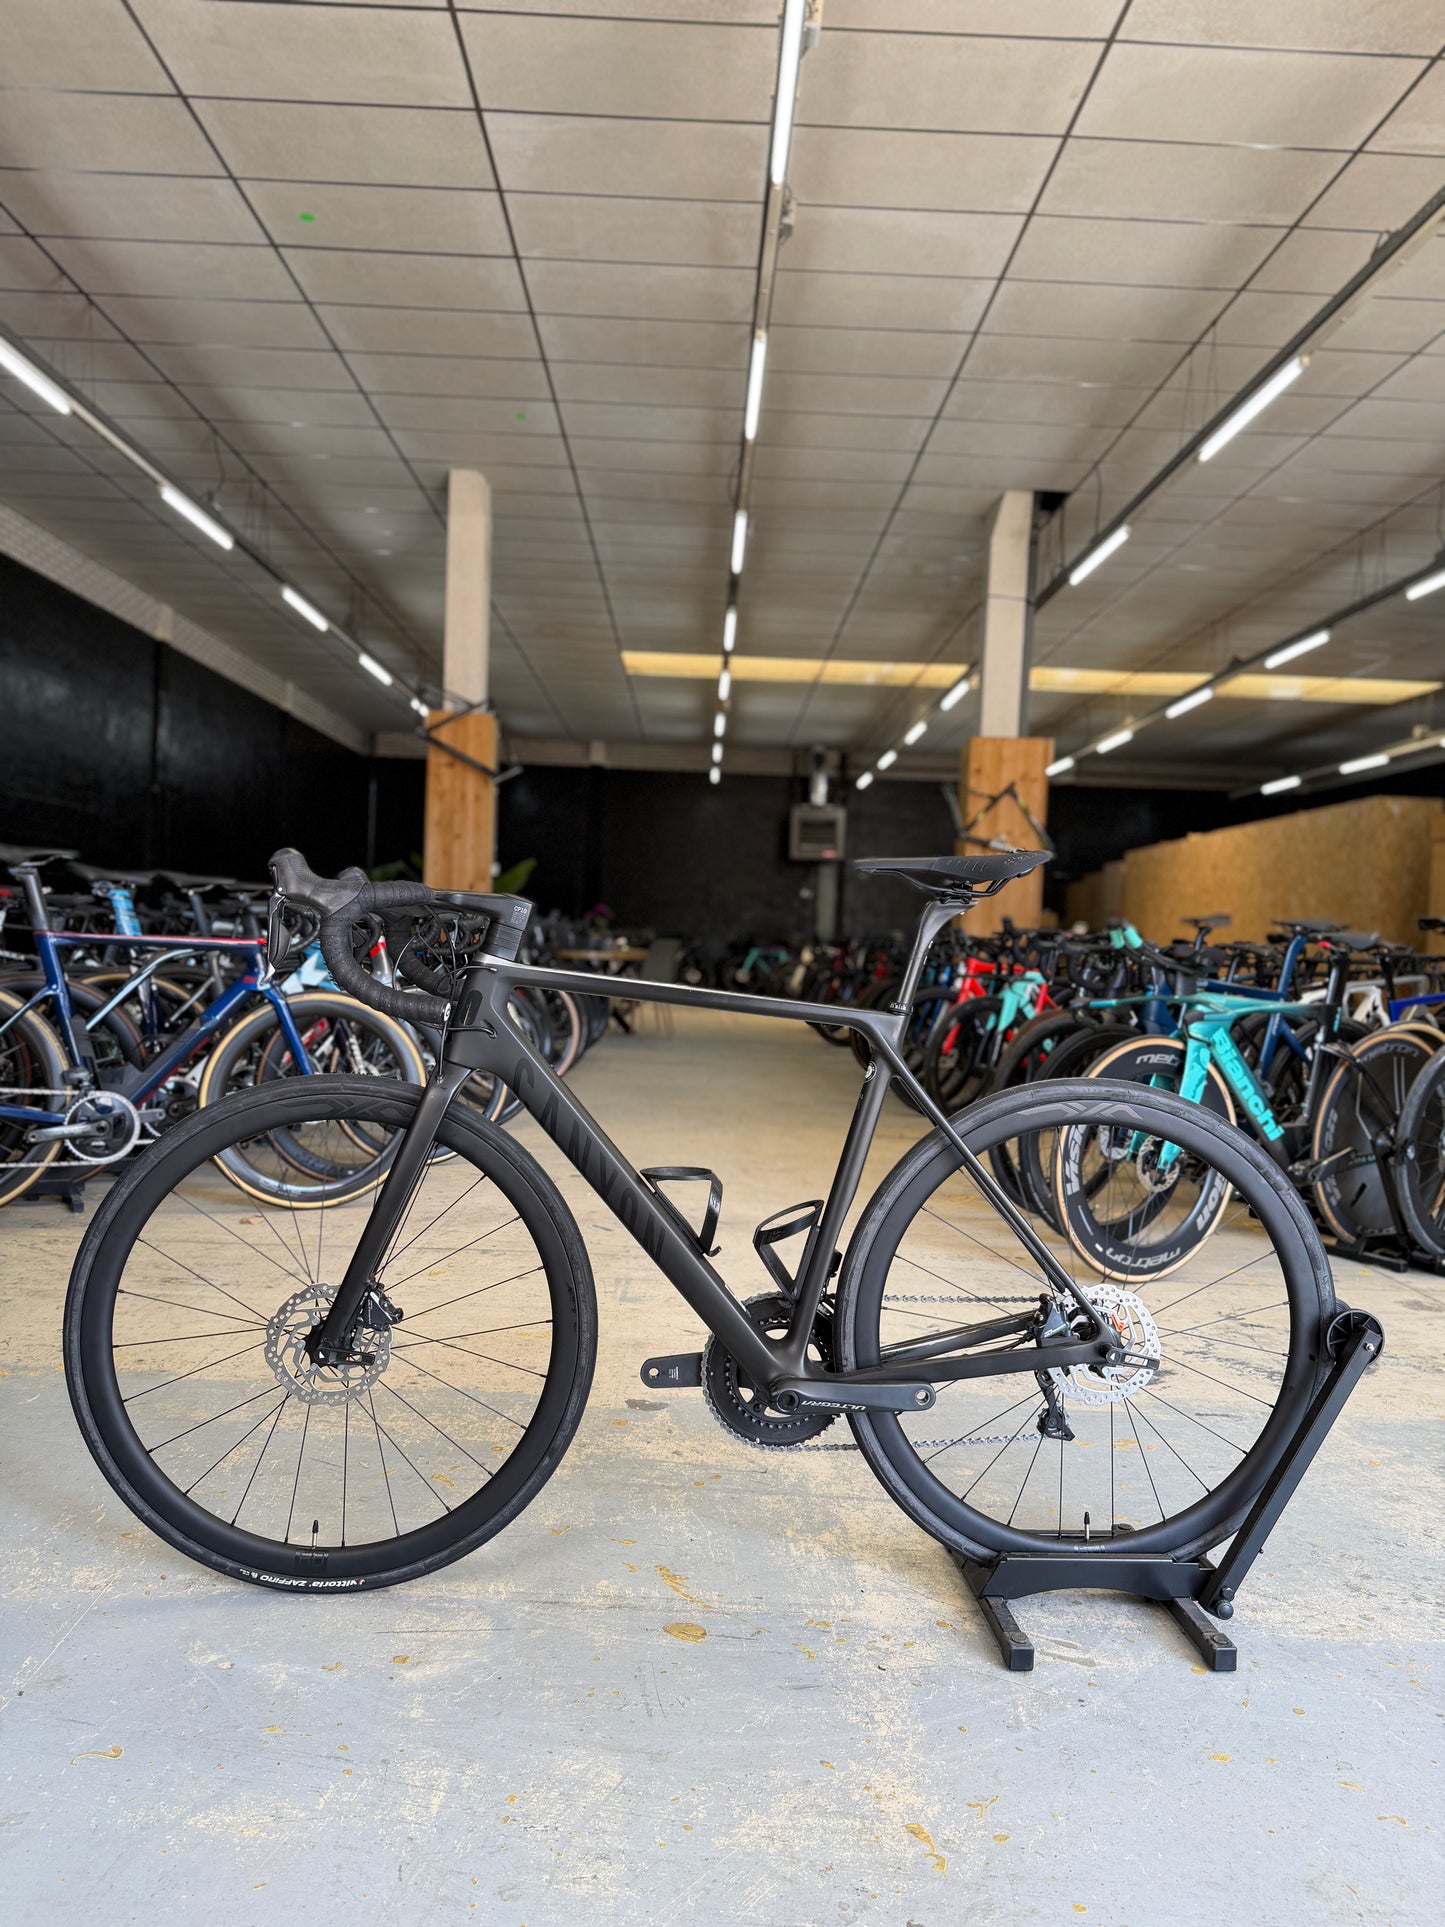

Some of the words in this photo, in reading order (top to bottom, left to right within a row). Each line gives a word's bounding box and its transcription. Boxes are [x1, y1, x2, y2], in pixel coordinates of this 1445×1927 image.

[1212, 1027, 1285, 1142] Bianchi
[512, 1057, 667, 1261] CANYON
[1106, 1246, 1181, 1269] metron
[801, 1400, 867, 1411] ULTEGRA
[260, 1574, 307, 1587] ZAFFIRO
[312, 1579, 358, 1588] vittoria
